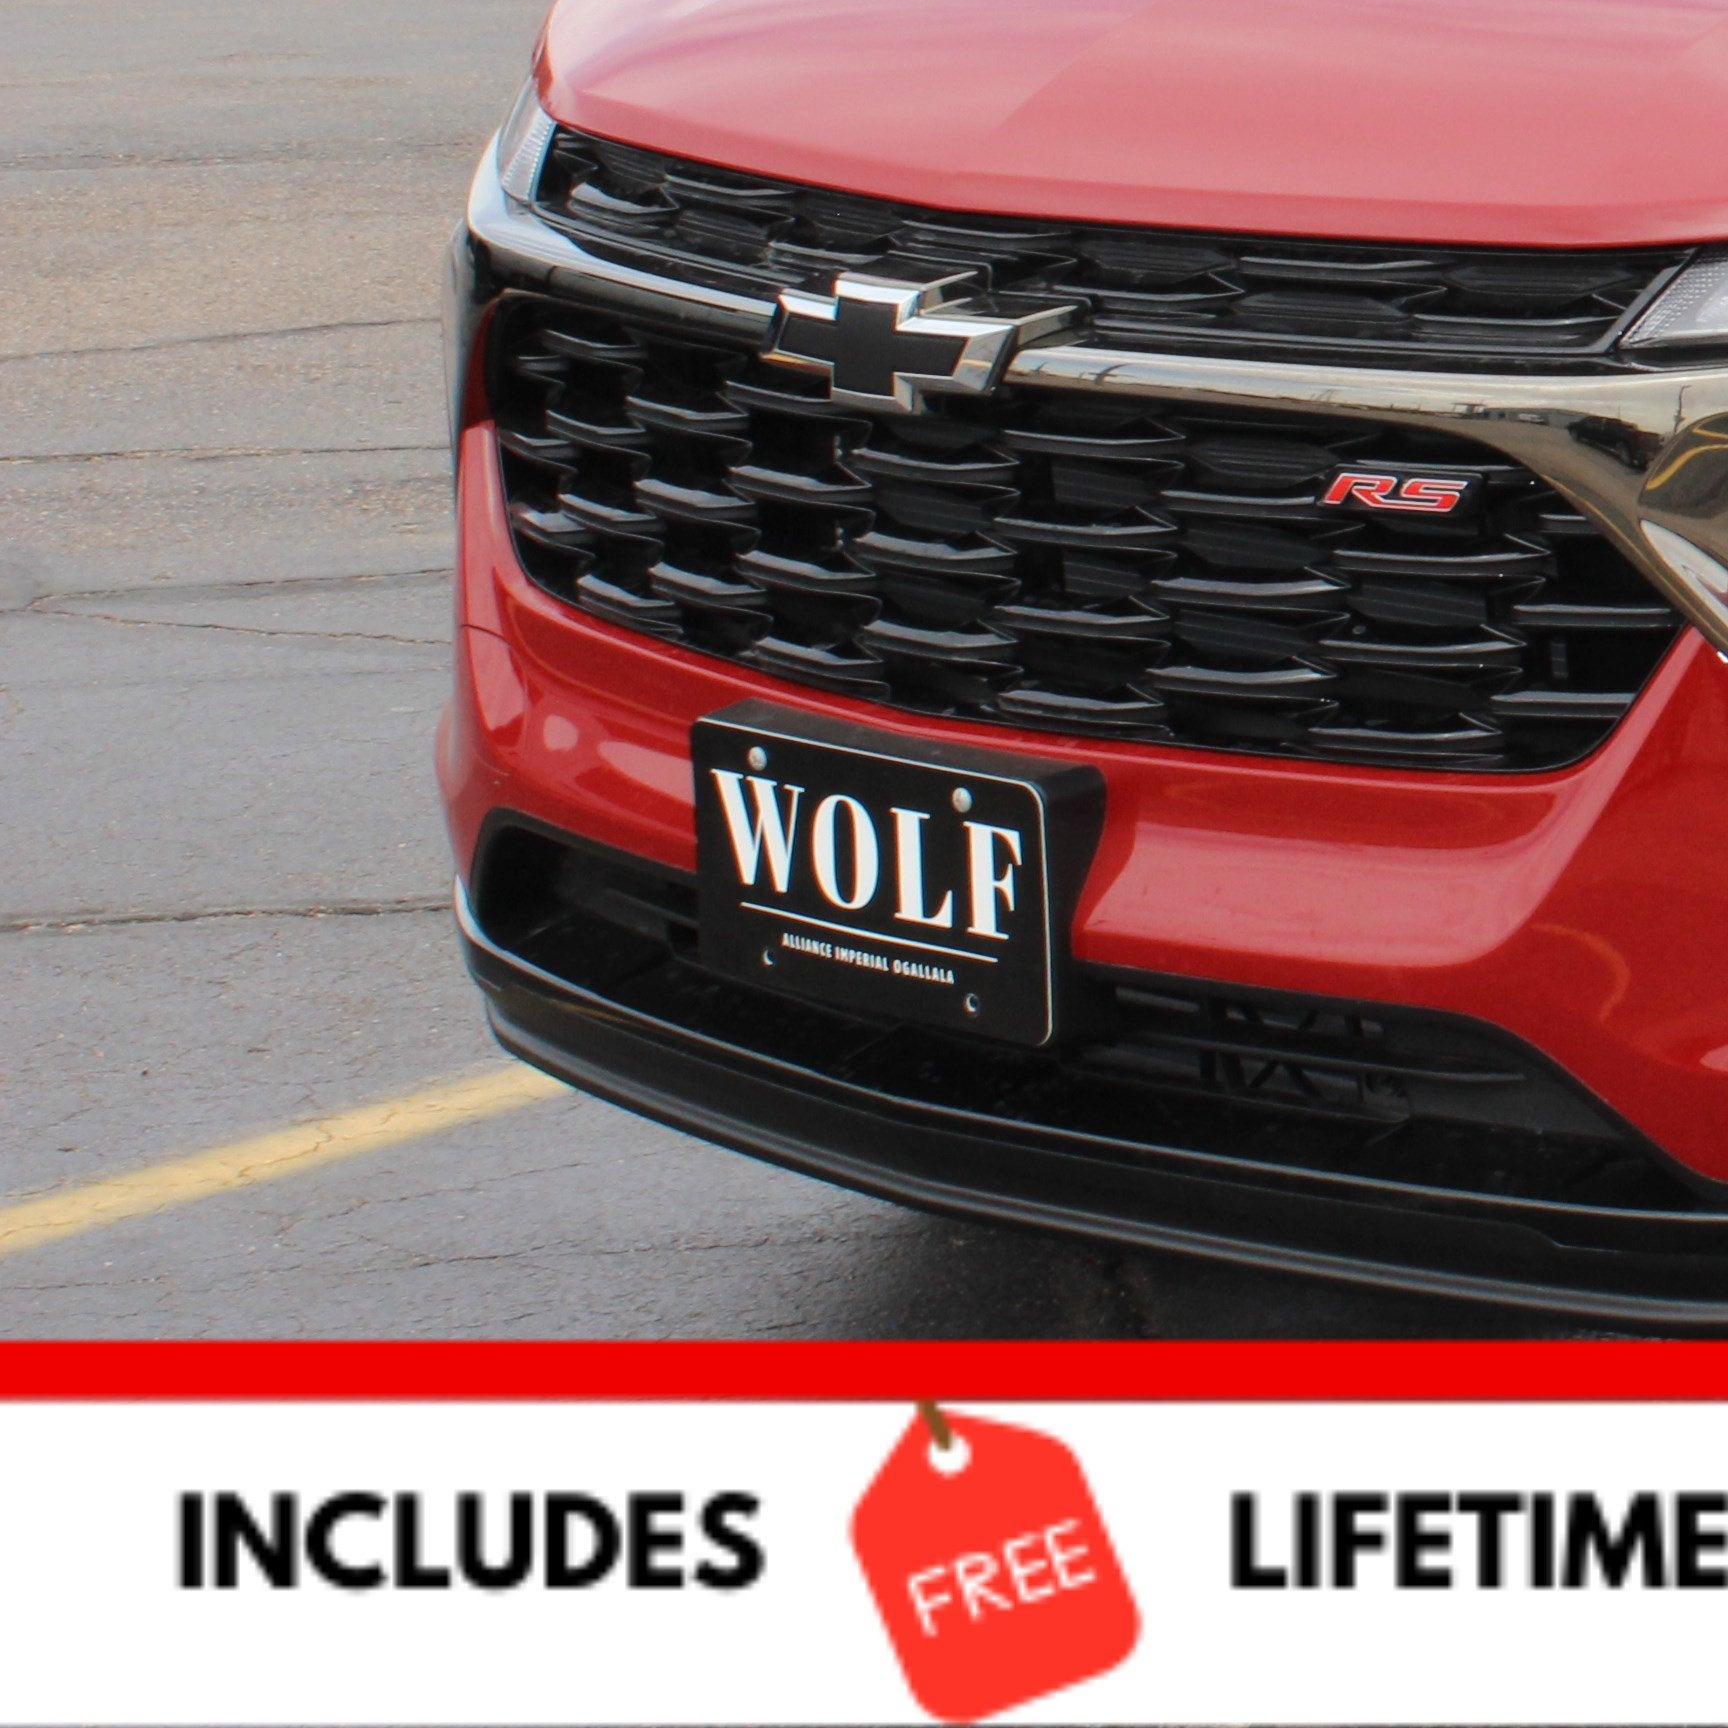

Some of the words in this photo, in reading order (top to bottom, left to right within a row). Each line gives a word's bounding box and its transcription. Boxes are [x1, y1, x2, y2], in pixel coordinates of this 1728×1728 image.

[1323, 472, 1469, 513] RS
[711, 768, 1023, 941] WOLF
[781, 932, 833, 959] ALLIANCE
[834, 945, 889, 972] IMPERIAL
[892, 959, 955, 985] OGALLALA
